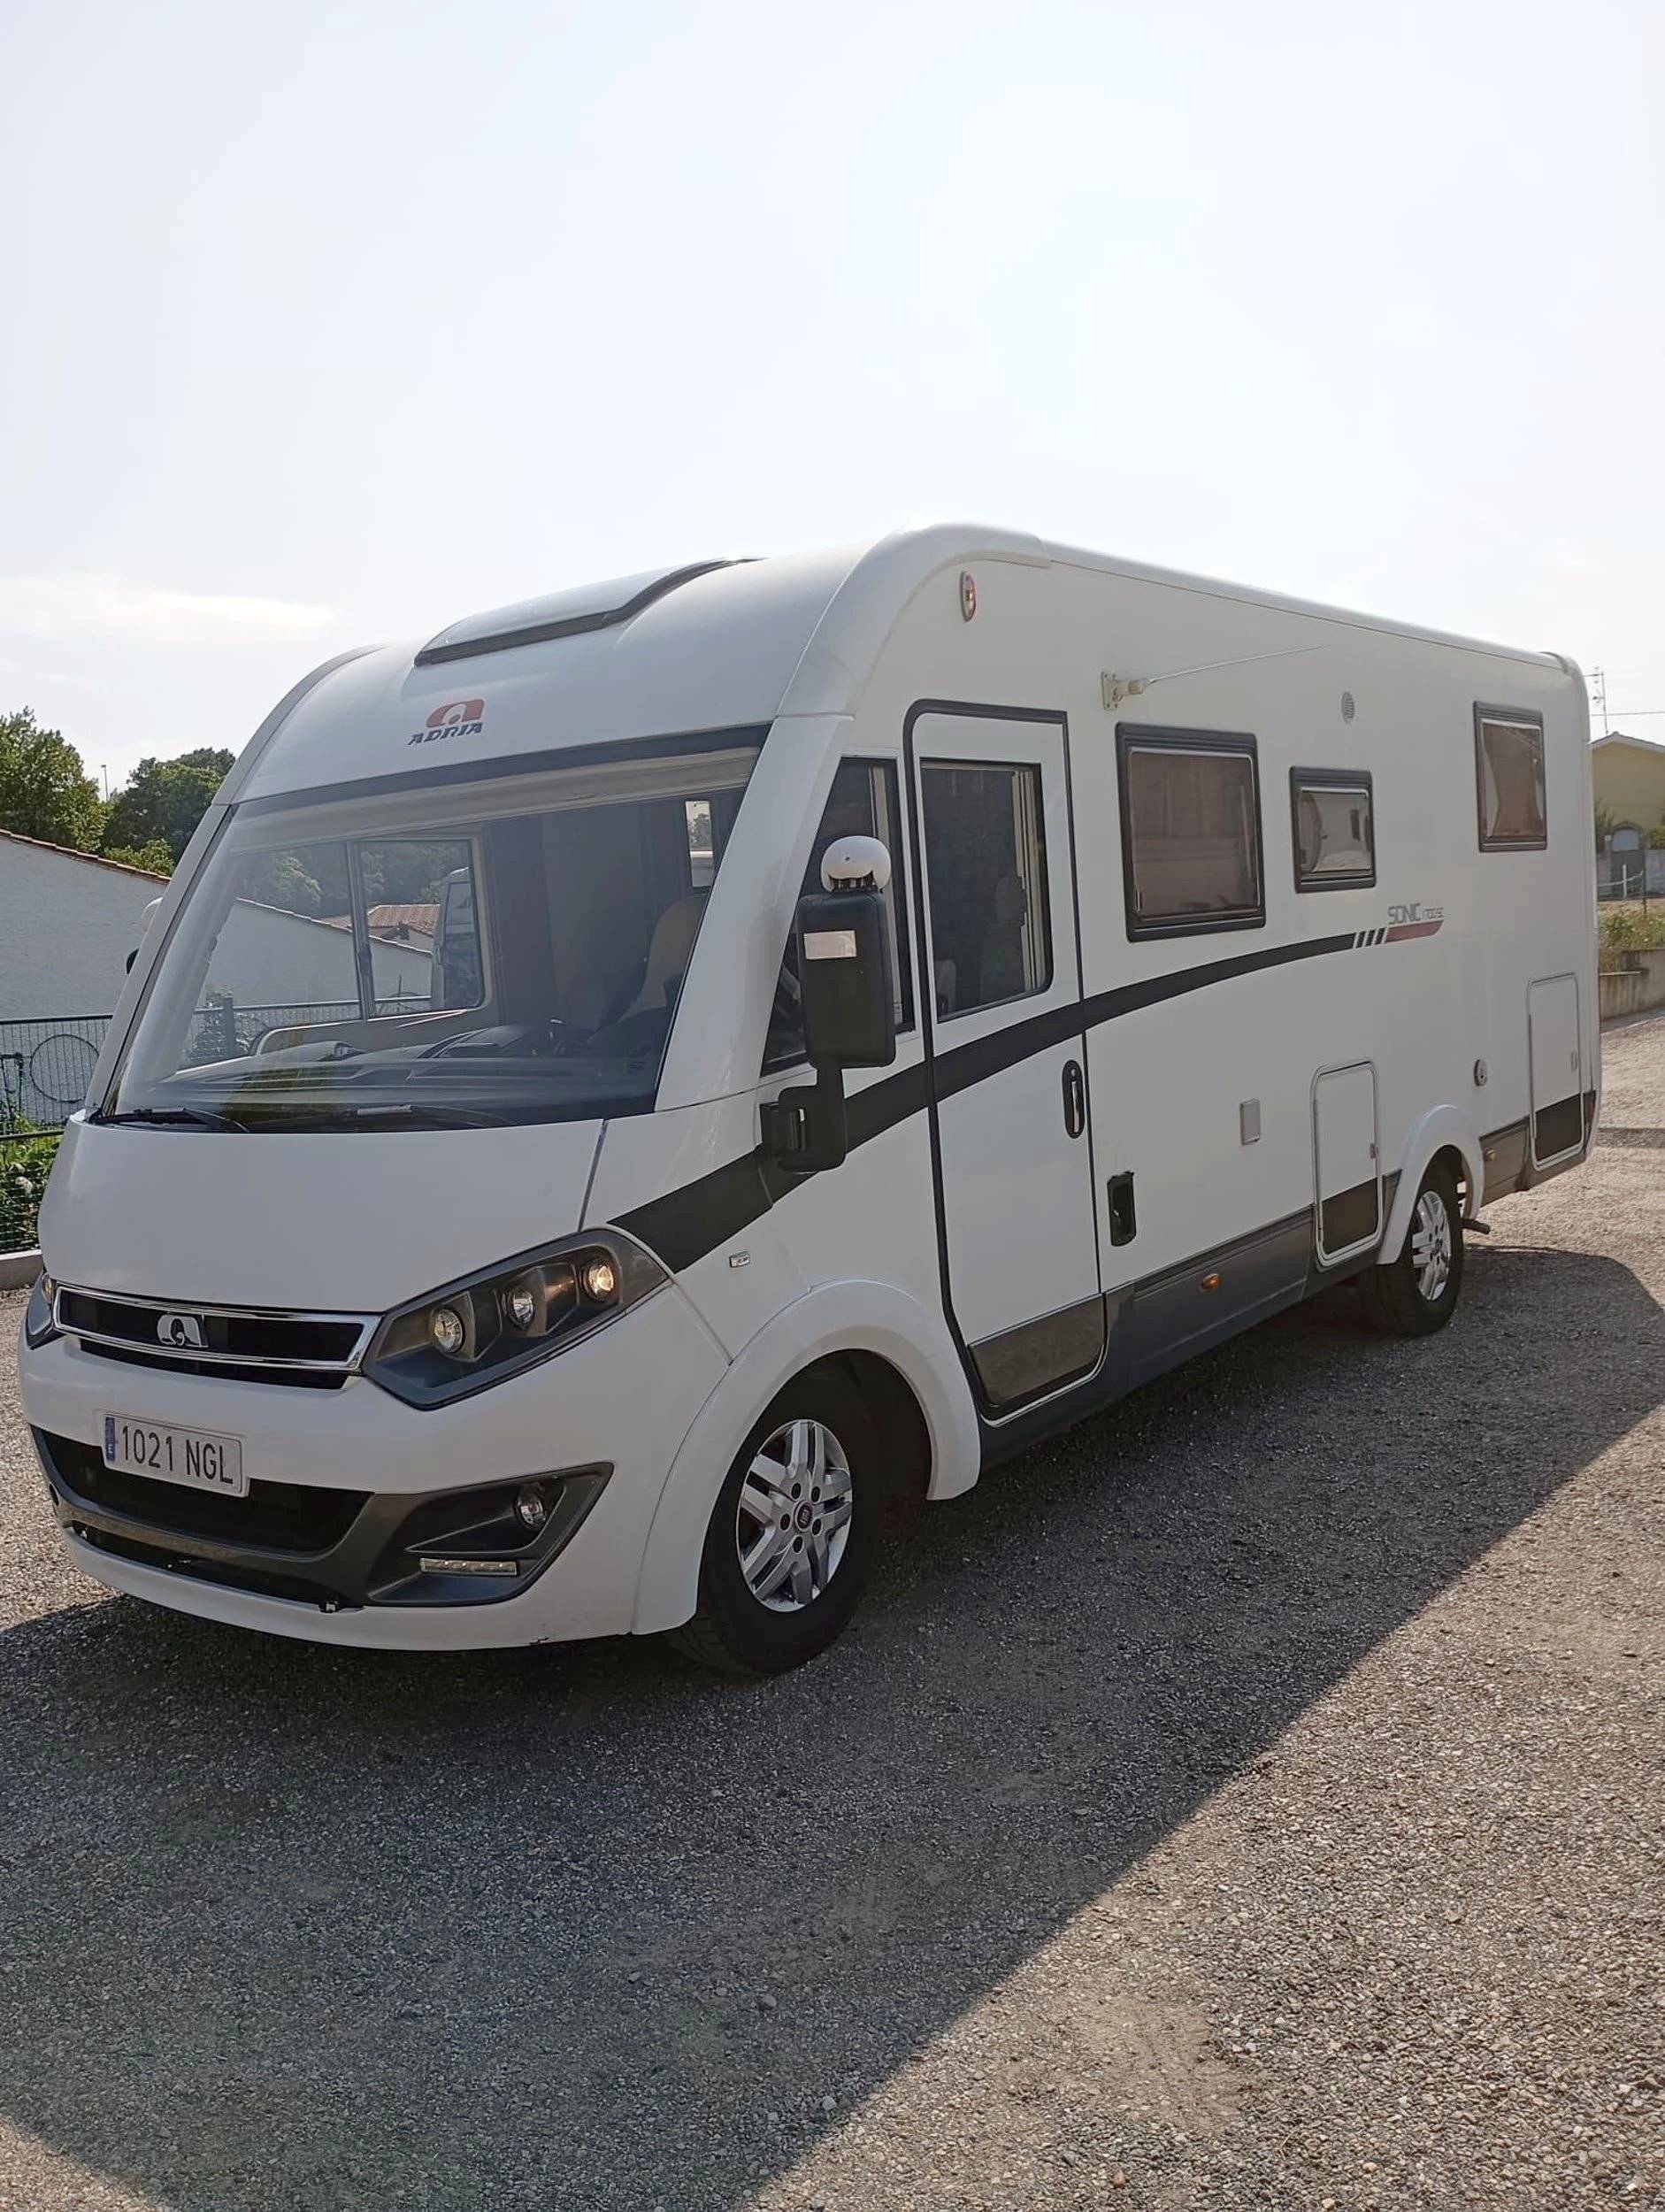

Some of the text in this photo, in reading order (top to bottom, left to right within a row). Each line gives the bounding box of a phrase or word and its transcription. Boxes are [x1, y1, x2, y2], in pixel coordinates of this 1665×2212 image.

[407, 722, 483, 746] ADRIA
[122, 1425, 234, 1485] 1021 NGL
